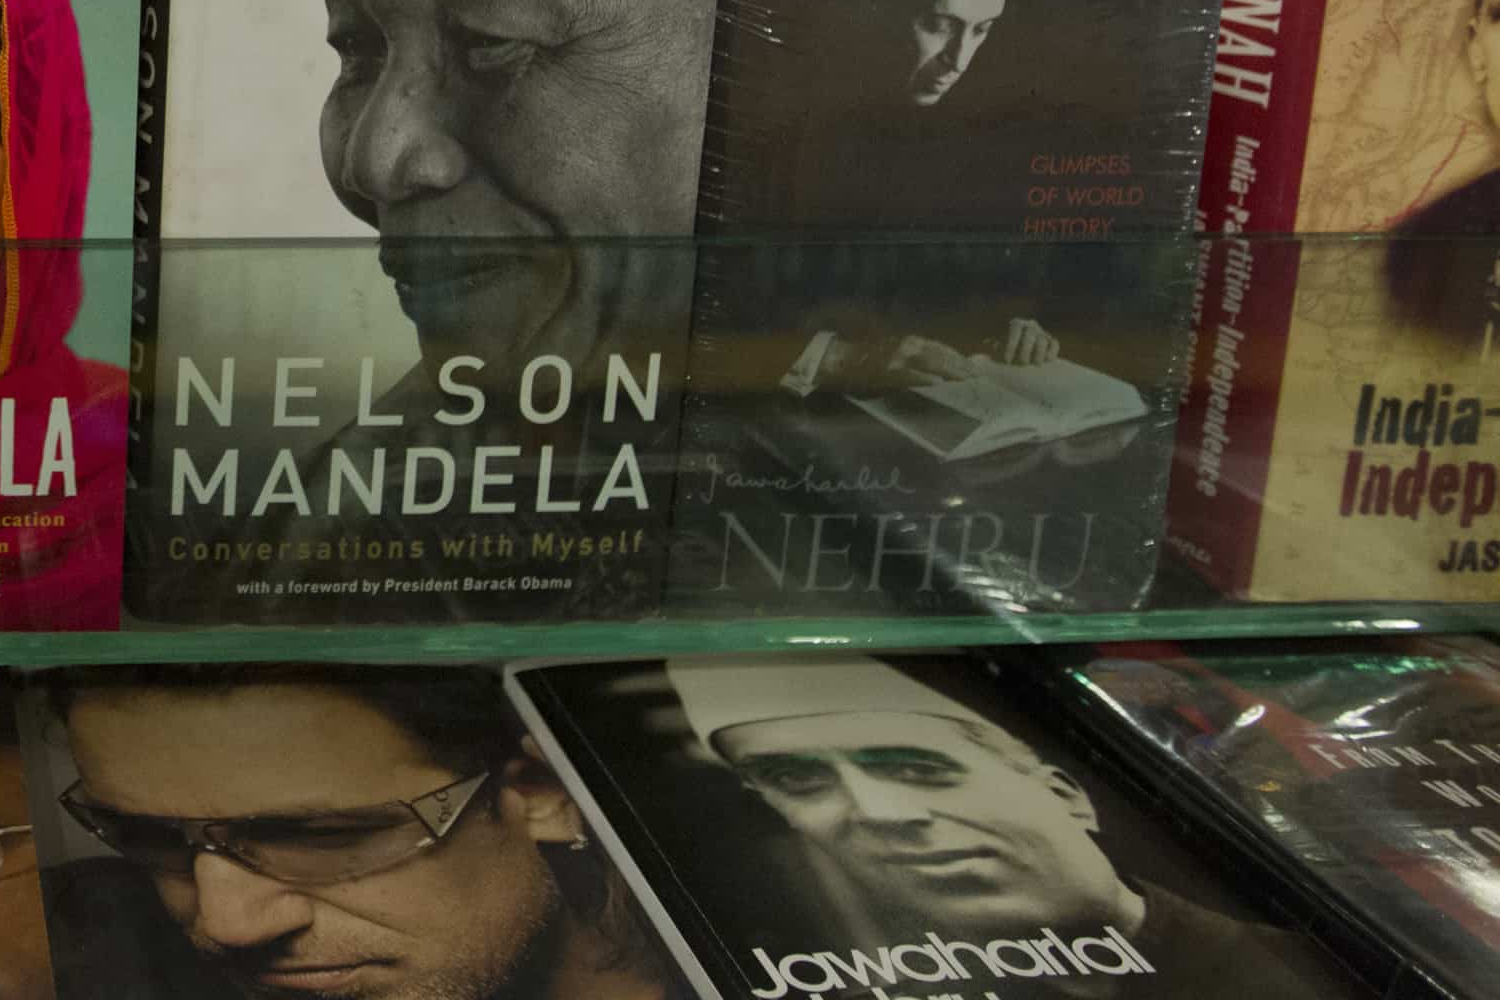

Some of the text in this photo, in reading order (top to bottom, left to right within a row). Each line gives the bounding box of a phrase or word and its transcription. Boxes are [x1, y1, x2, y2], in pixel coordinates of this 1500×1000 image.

[1030, 153, 1133, 176] GLIMPSES
[1026, 184, 1145, 208] OF WORLD
[1023, 215, 1115, 237] HISTORY
[174, 352, 661, 428] NELSON
[169, 442, 650, 517] MANDELA
[1339, 449, 1497, 528] Indep
[168, 528, 644, 562] Conversations with Myself
[707, 511, 1101, 593] NEHRU
[1438, 539, 1500, 572] JAS
[236, 575, 572, 597] with a foreword by President Barack Obama
[750, 924, 1158, 1000] Jawaharlal
